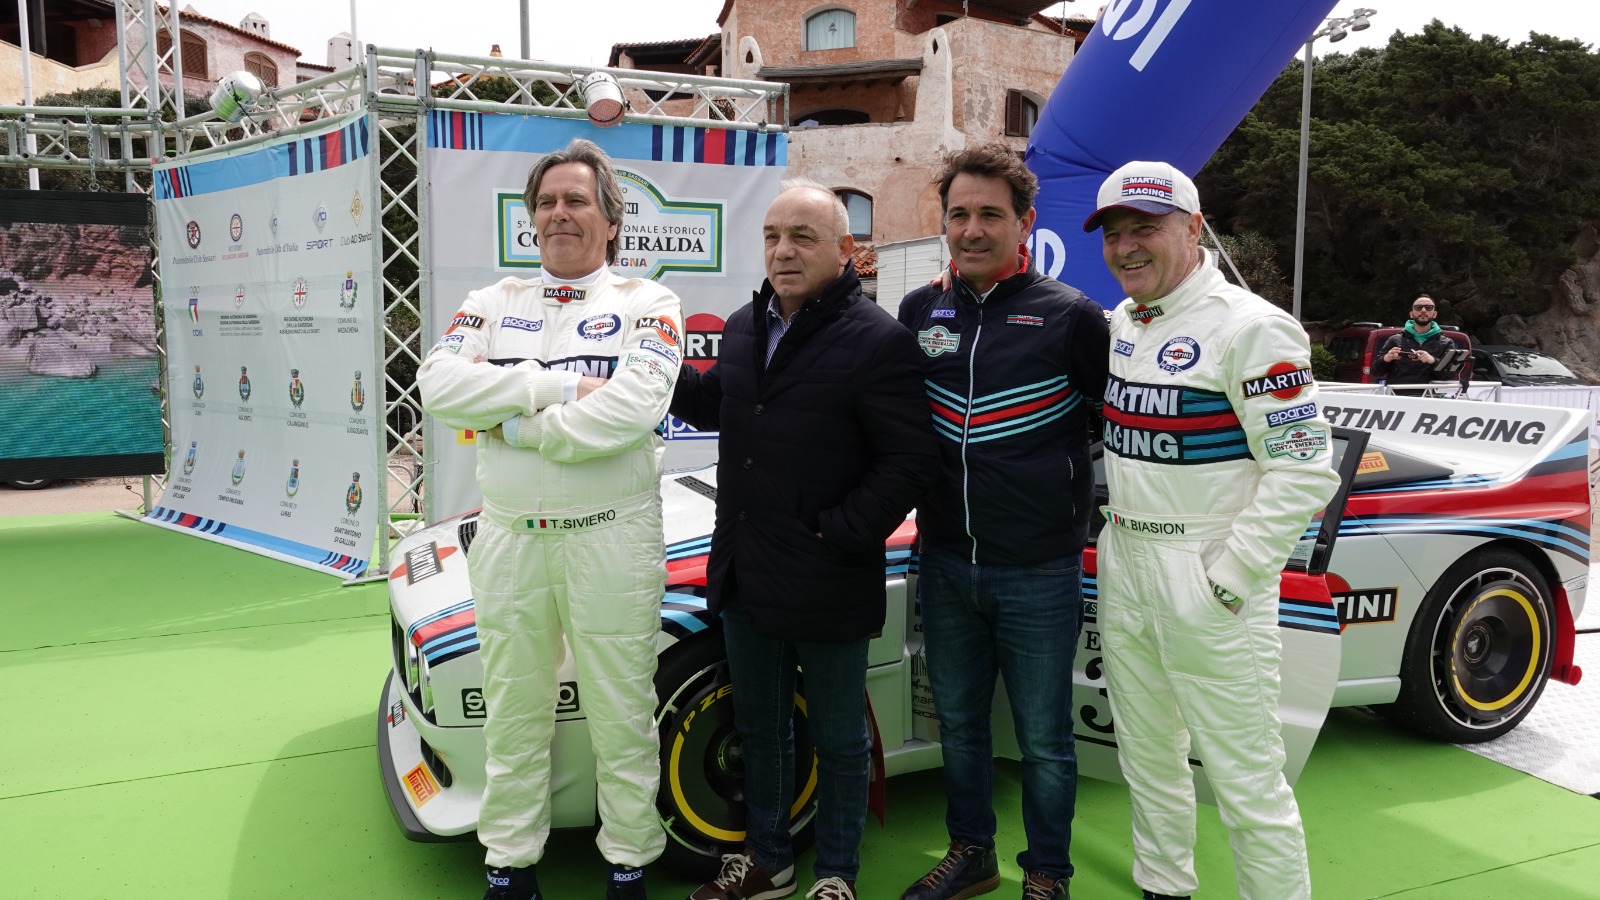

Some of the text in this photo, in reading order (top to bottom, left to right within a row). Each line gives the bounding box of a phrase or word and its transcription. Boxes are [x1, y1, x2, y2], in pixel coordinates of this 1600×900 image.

[1129, 177, 1166, 186] MARTINI
[1128, 188, 1165, 198] RACING
[662, 226, 706, 236] STORICO
[306, 239, 334, 250] SPORT
[620, 236, 705, 253] ERALDA
[613, 257, 647, 267] EGNA
[545, 288, 585, 299] MARTINI
[1131, 307, 1162, 320] MARTINI
[452, 316, 482, 327] TINI
[503, 317, 542, 331] sparco
[585, 322, 613, 331] MARTINI
[640, 318, 681, 343] MARTI
[642, 341, 679, 366] sparco
[1116, 341, 1133, 355] parco
[1165, 350, 1192, 359] MARTINI
[1269, 404, 1316, 425] sparco
[1322, 405, 1546, 446] RTINI RACING
[1104, 420, 1179, 459] ACING
[1271, 444, 1293, 453] COSTA
[1358, 460, 1384, 471] RELLI
[550, 509, 616, 529] T.SIVIERO
[1130, 519, 1185, 534] BIASION
[410, 542, 438, 582] MARTINI
[1331, 593, 1392, 620] TINI
[683, 683, 733, 733] P ZE
[407, 767, 435, 803] PIRELLI
[613, 869, 643, 882] sparco
